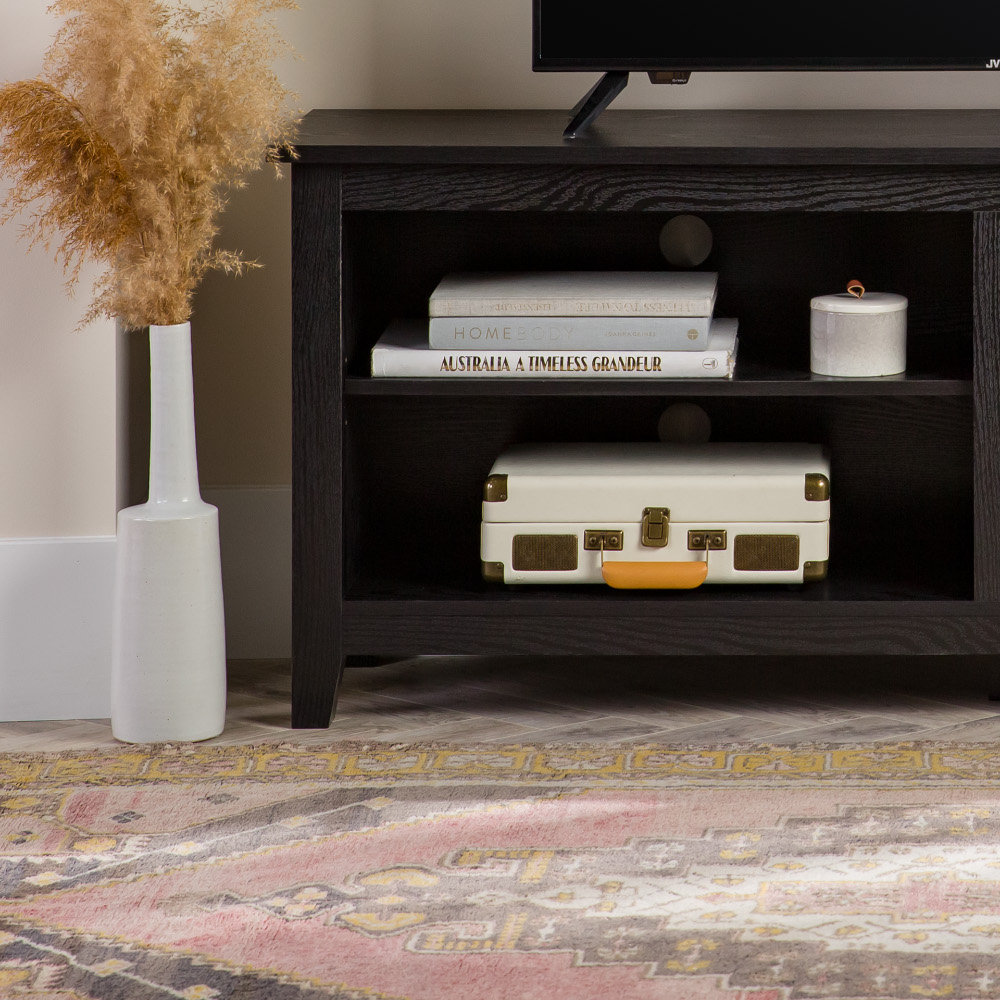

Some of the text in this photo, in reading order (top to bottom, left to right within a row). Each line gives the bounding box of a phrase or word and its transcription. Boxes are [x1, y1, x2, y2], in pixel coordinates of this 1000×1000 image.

[440, 356, 662, 372] AUSTRALIA A TIMELESS GRANDEUR
